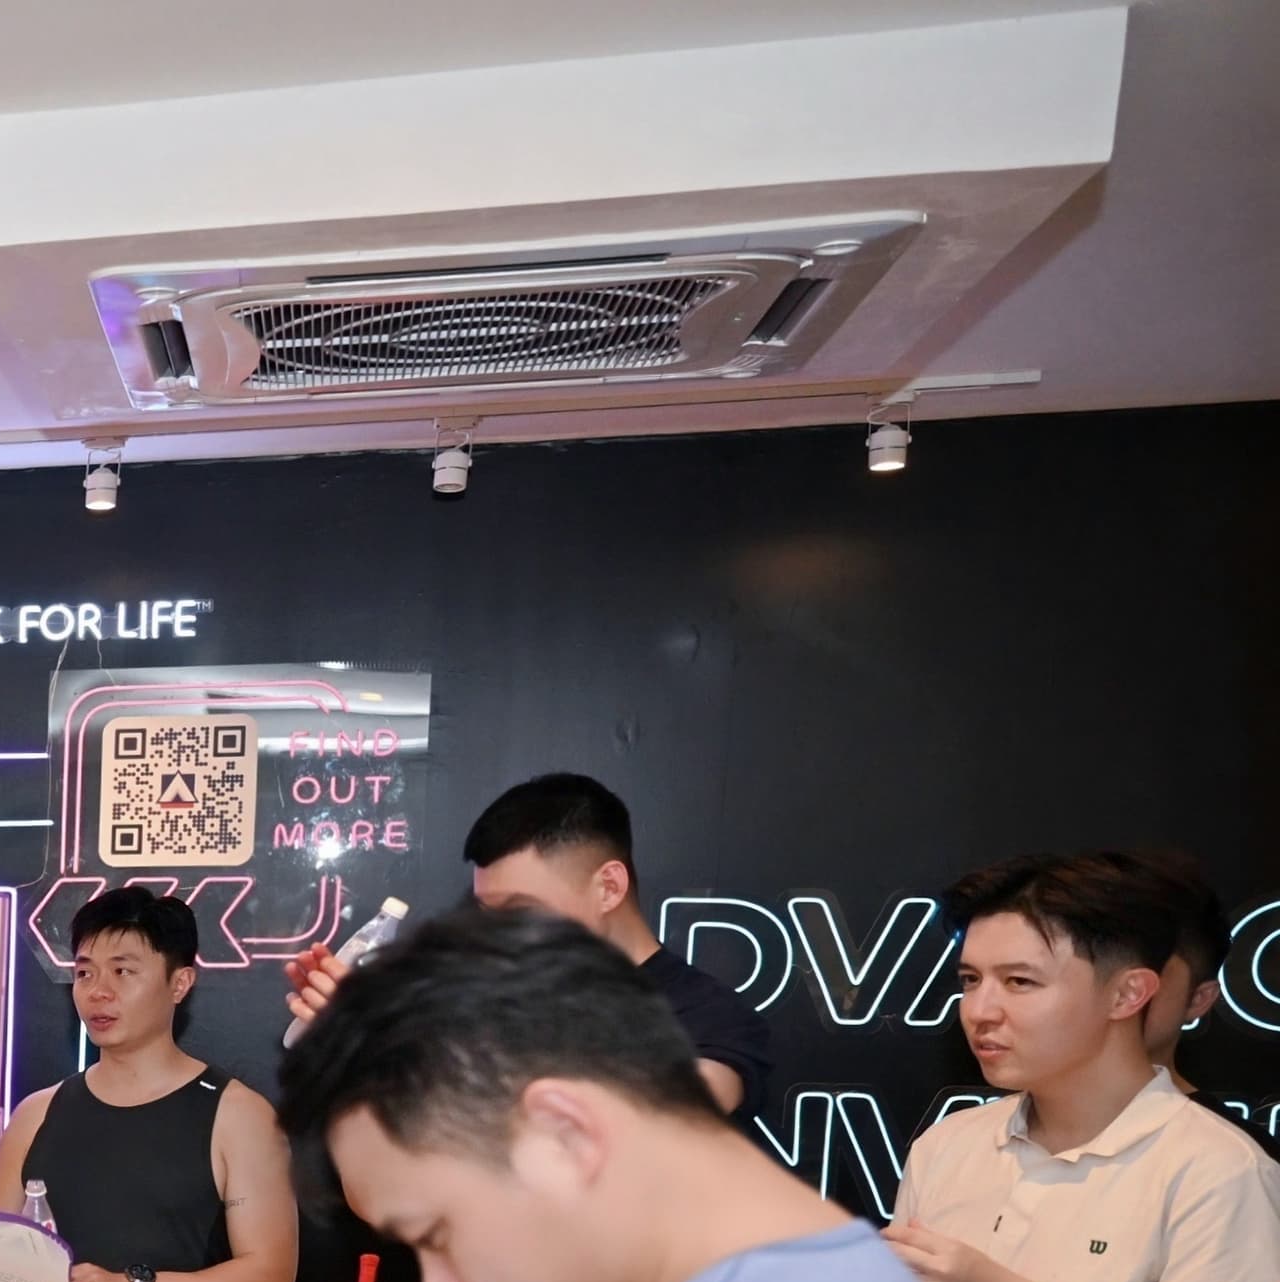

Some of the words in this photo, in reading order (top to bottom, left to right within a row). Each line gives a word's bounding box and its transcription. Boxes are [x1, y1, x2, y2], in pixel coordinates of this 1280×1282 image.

[19, 602, 103, 643] FOR
[289, 728, 401, 758] FIND
[292, 775, 391, 804] OUT
[273, 820, 409, 850] MORE
